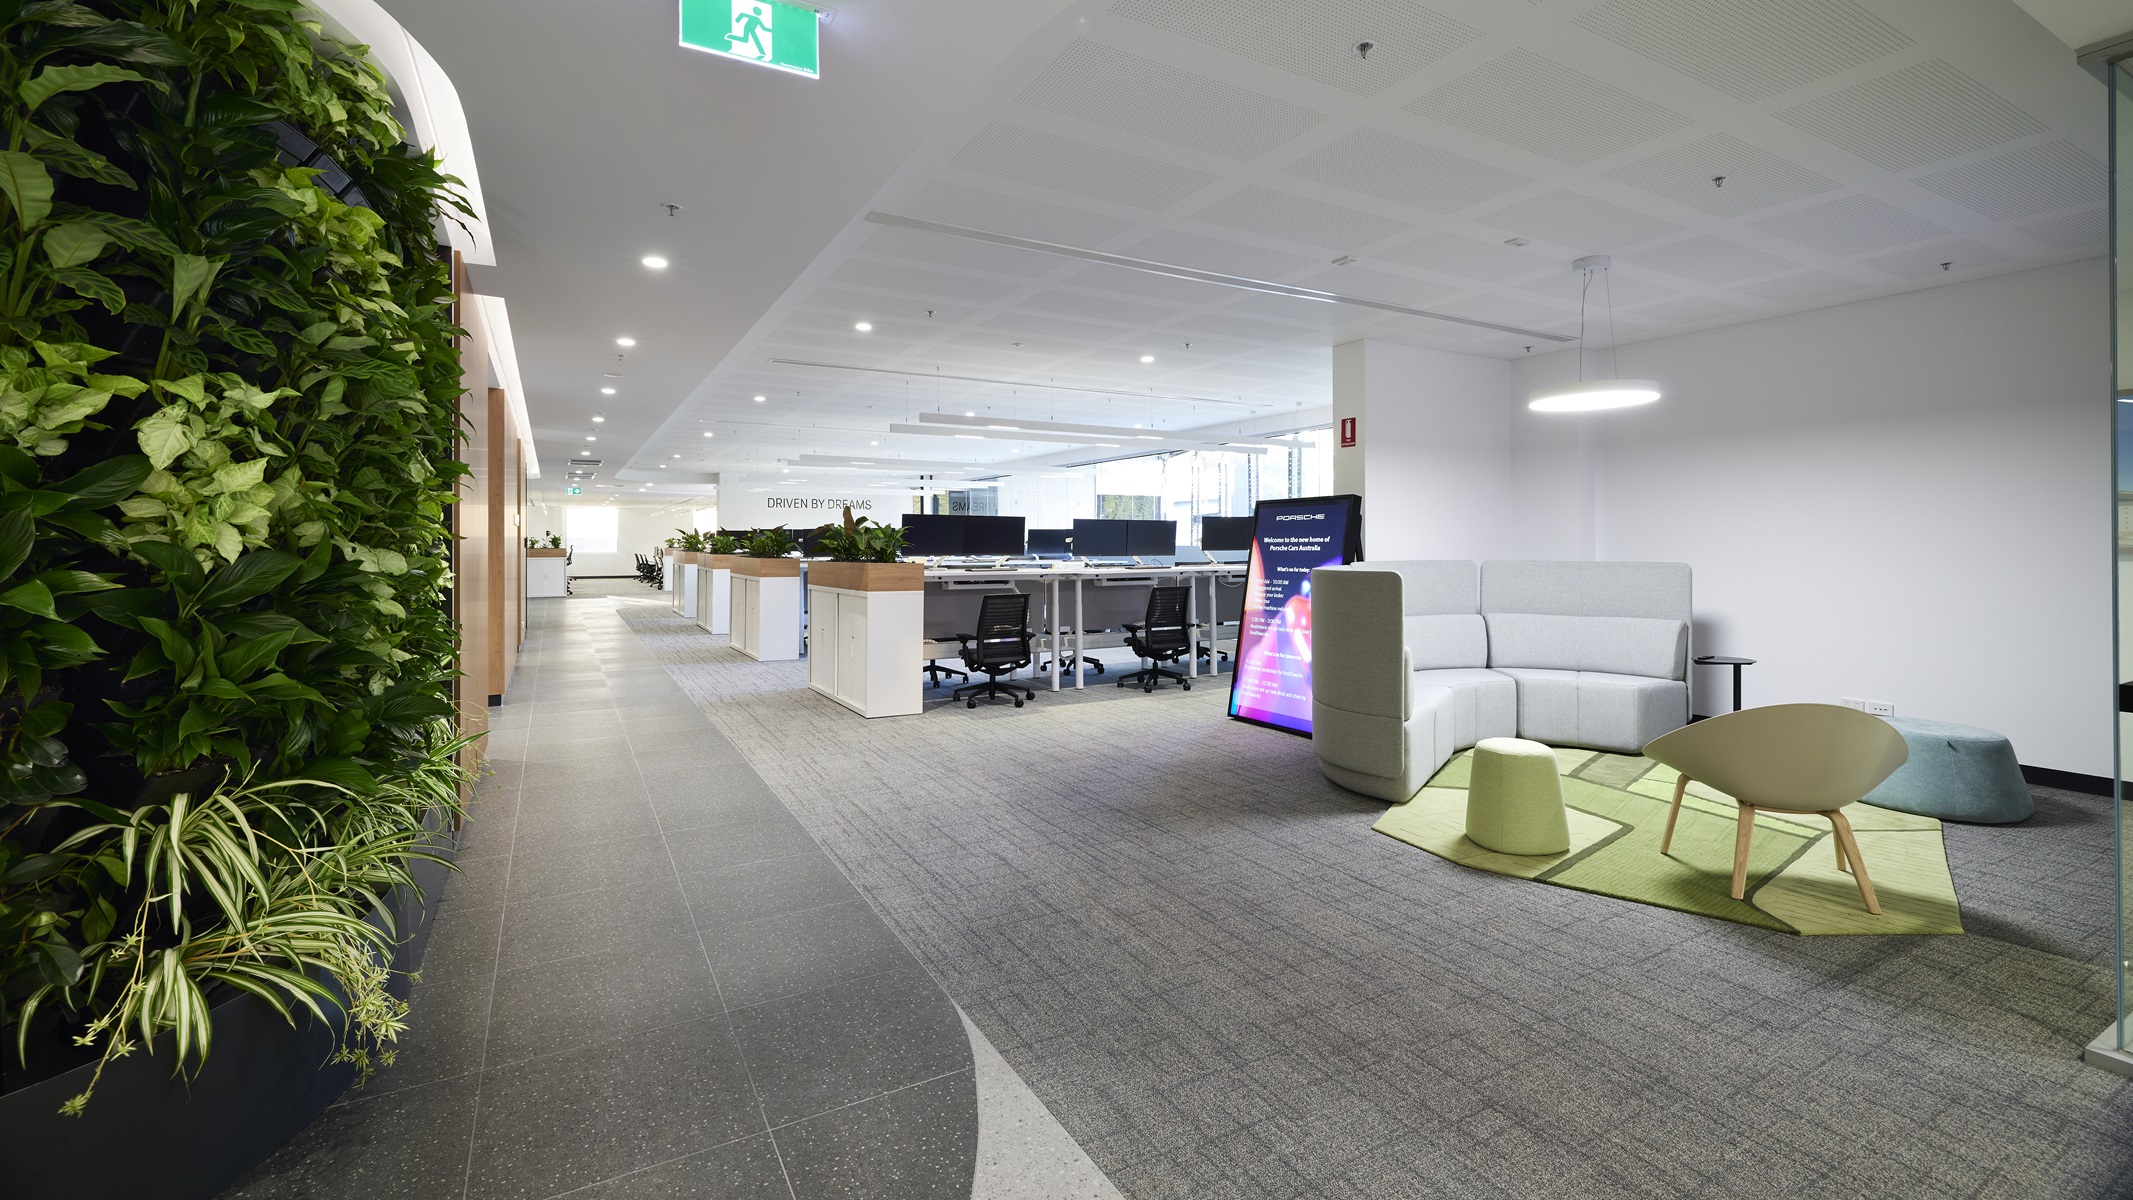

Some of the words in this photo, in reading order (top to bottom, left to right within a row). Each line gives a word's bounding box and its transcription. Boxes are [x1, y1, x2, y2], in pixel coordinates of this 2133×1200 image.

[767, 497, 808, 509] DRIVEN
[811, 498, 825, 509] BY
[828, 499, 872, 510] DREAMS
